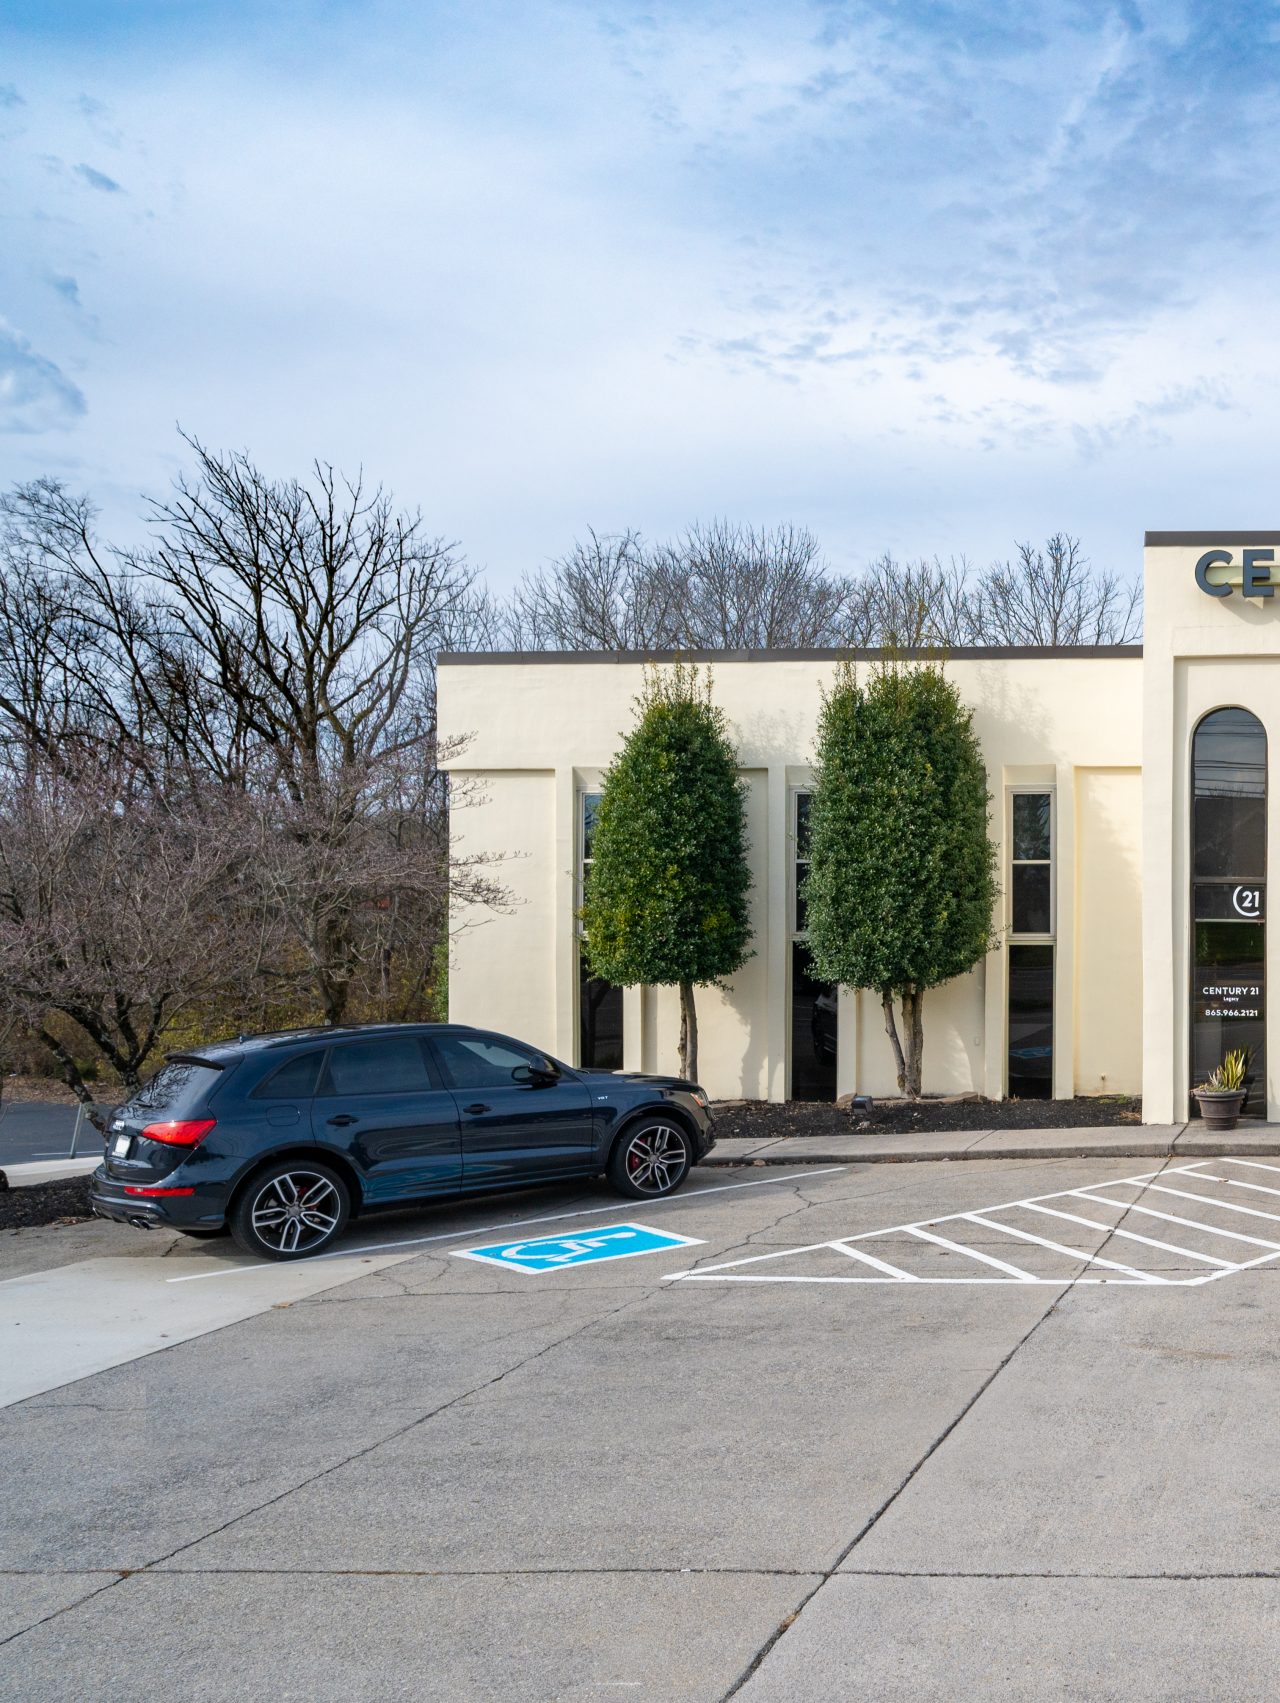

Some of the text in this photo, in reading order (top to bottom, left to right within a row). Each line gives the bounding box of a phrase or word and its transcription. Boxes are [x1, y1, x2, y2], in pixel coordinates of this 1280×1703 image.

[1202, 986, 1259, 995] CENTURY 21
[1205, 1009, 1258, 1017] 865.966.2121
